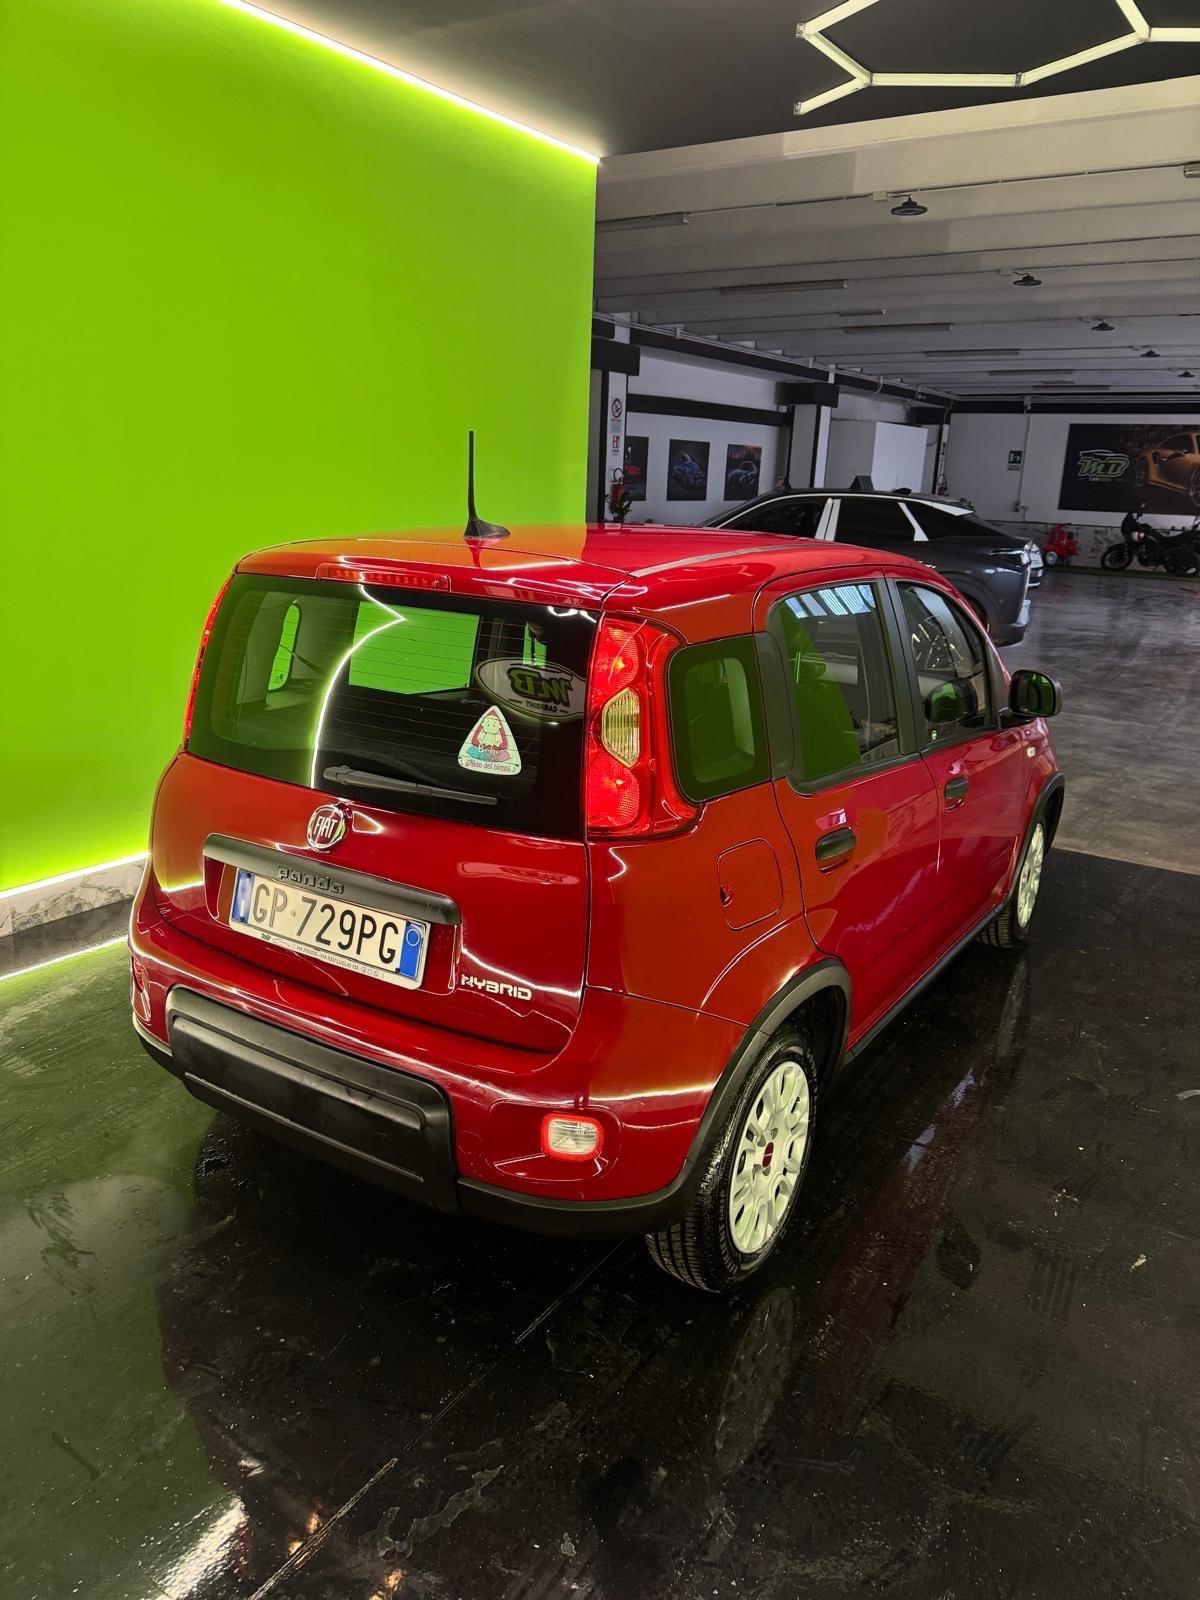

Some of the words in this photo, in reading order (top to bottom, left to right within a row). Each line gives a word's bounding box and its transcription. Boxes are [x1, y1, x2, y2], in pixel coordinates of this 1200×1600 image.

[313, 815, 338, 838] FIAT
[278, 866, 344, 894] panda
[296, 897, 399, 964] 729PG
[461, 974, 532, 1001] HYBRID
